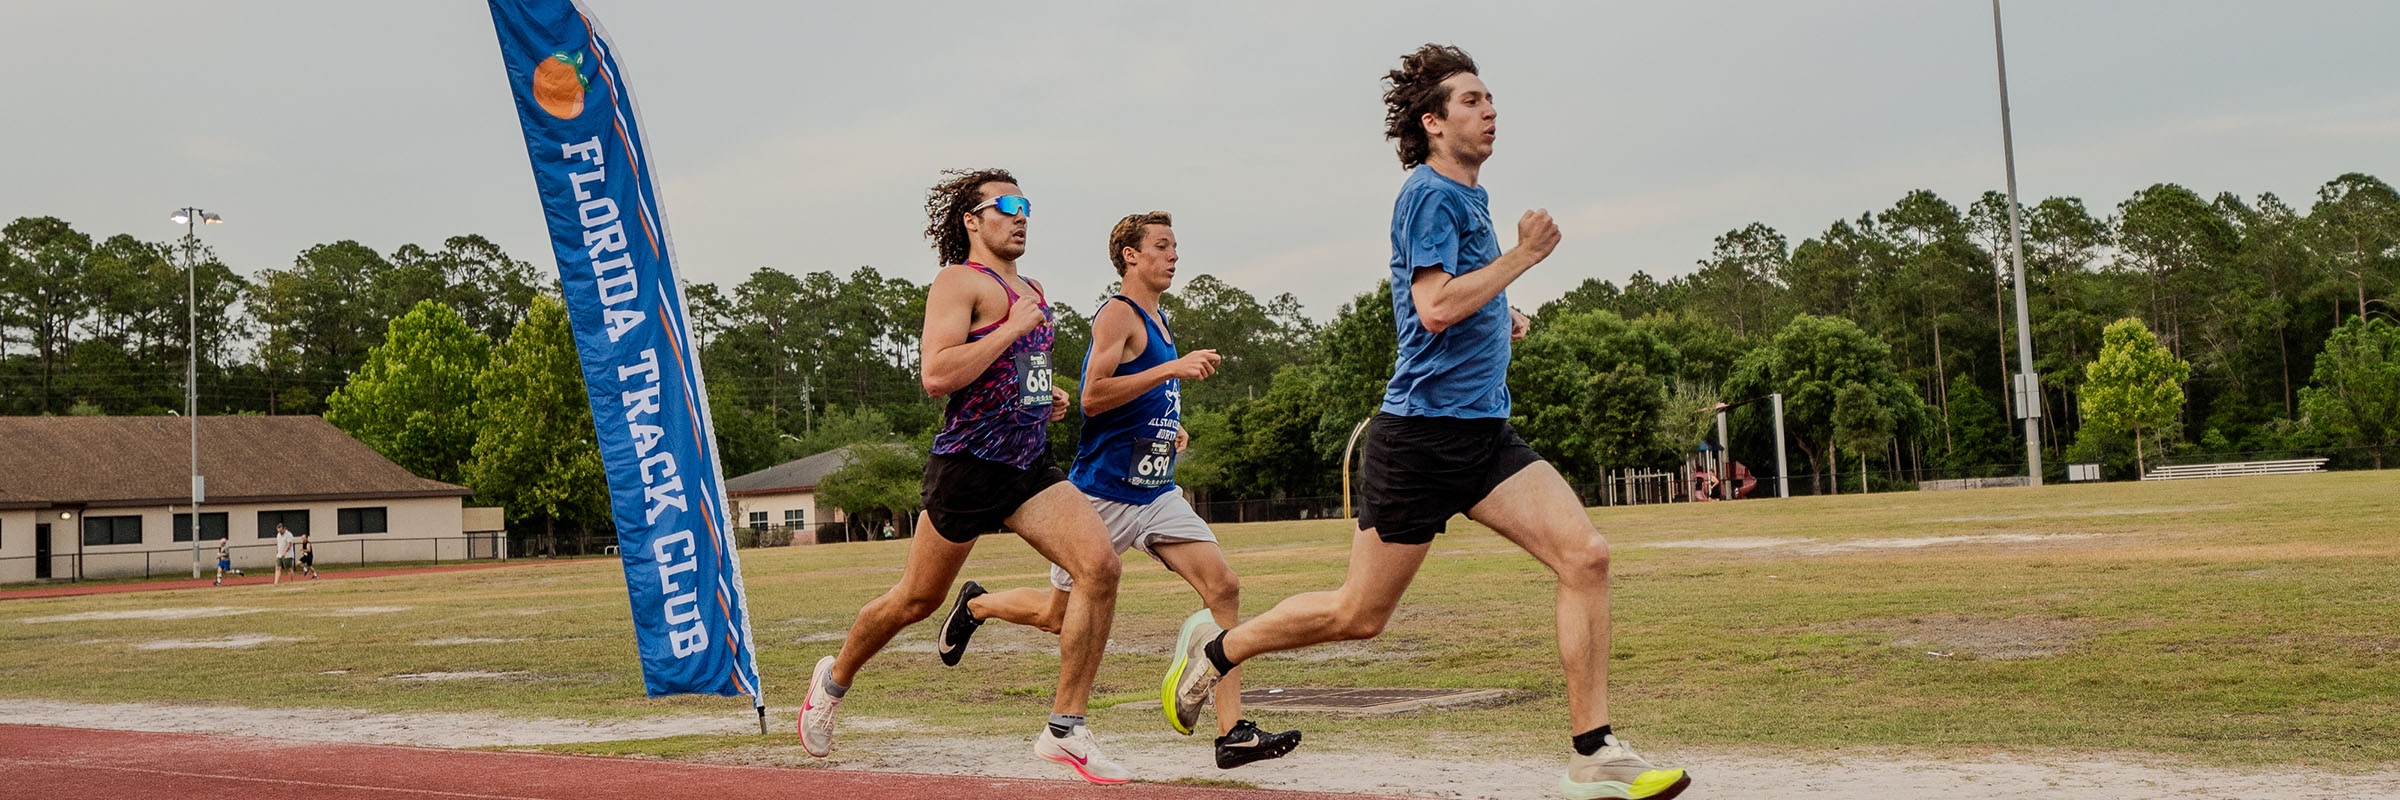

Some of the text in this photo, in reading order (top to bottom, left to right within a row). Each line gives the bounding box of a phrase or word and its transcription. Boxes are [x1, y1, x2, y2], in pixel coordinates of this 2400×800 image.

[1026, 368, 1052, 393] 687
[561, 136, 709, 660] FLORIDA TRACK CLUB
[1137, 455, 1170, 477] 699
